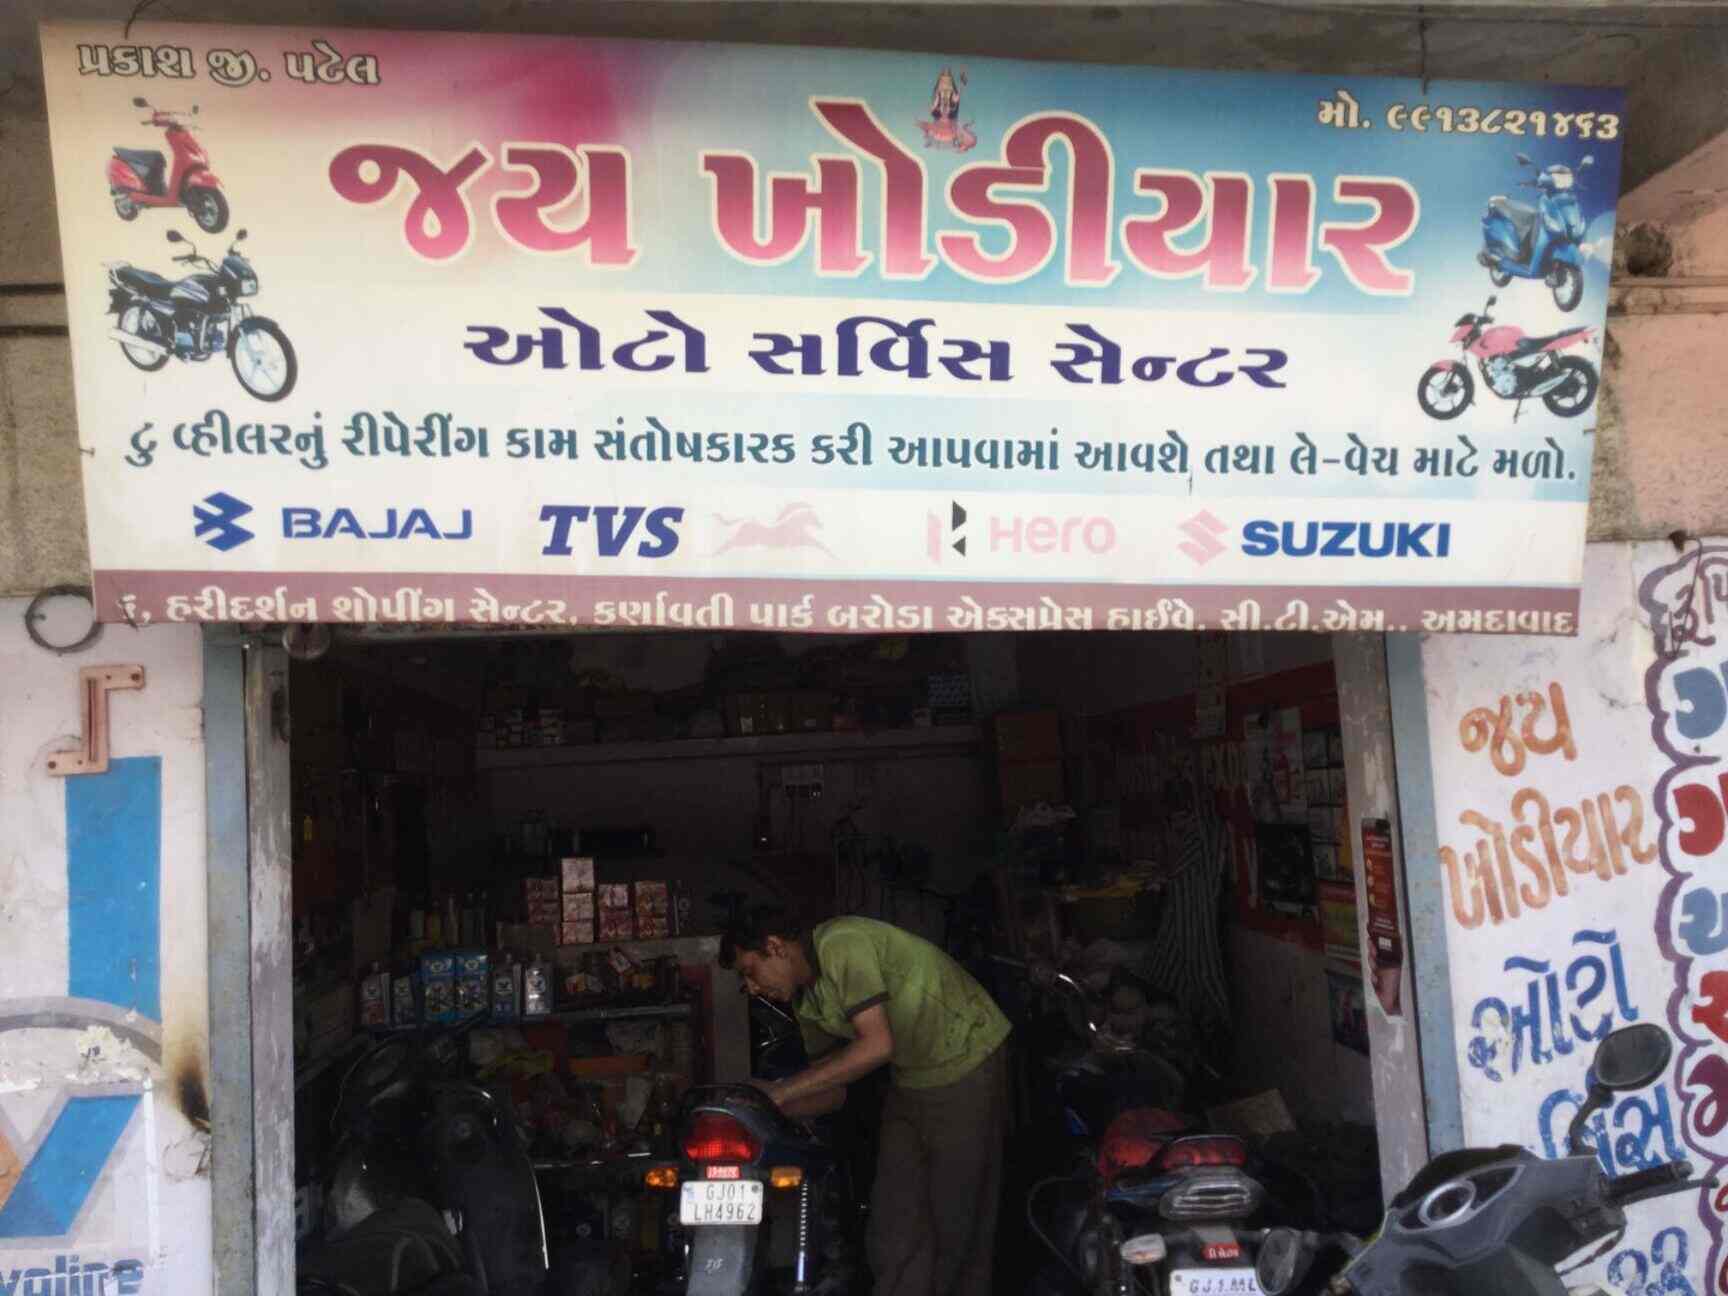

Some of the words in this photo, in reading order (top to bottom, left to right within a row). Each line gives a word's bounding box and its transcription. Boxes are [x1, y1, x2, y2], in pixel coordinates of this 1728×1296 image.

[77, 45, 196, 78] પ્રકાશ
[206, 48, 271, 87] જી.
[284, 40, 381, 85] પટેલ
[1317, 89, 1371, 128] મો.
[328, 143, 640, 270] જય
[698, 95, 1421, 296] ખોડીયાર
[463, 306, 710, 373] ઓટો
[748, 316, 1015, 381] સર્વિસ
[1050, 323, 1288, 388] સેન્ટર
[125, 420, 157, 468] ટુ
[173, 409, 329, 469] વ્હીલરનું
[341, 411, 489, 460] રીપેરીંગ
[506, 427, 579, 460] કામ
[594, 416, 796, 464] સંતોષકારક
[811, 422, 873, 466] કરી
[888, 427, 1059, 471] આપવામાં
[1074, 430, 1190, 475] આવશે
[1205, 440, 1275, 476] તથા
[1289, 432, 1400, 478] લે-વેચ
[1413, 434, 1479, 480] માટે
[1493, 437, 1576, 481] મળો.
[281, 507, 473, 541] BAJAJ
[538, 505, 684, 559] TVS
[989, 515, 1117, 555] Hero
[1241, 520, 1452, 558] SUZUKI
[166, 585, 318, 622] હરીદર્શન
[332, 586, 455, 623] શોપીંગ
[593, 591, 734, 627] કર્ણાવતી
[750, 593, 815, 629] પાર્ક
[827, 594, 933, 630] બરોડા
[1460, 681, 1577, 777] જય
[1440, 784, 1658, 929] ખોડીયાર
